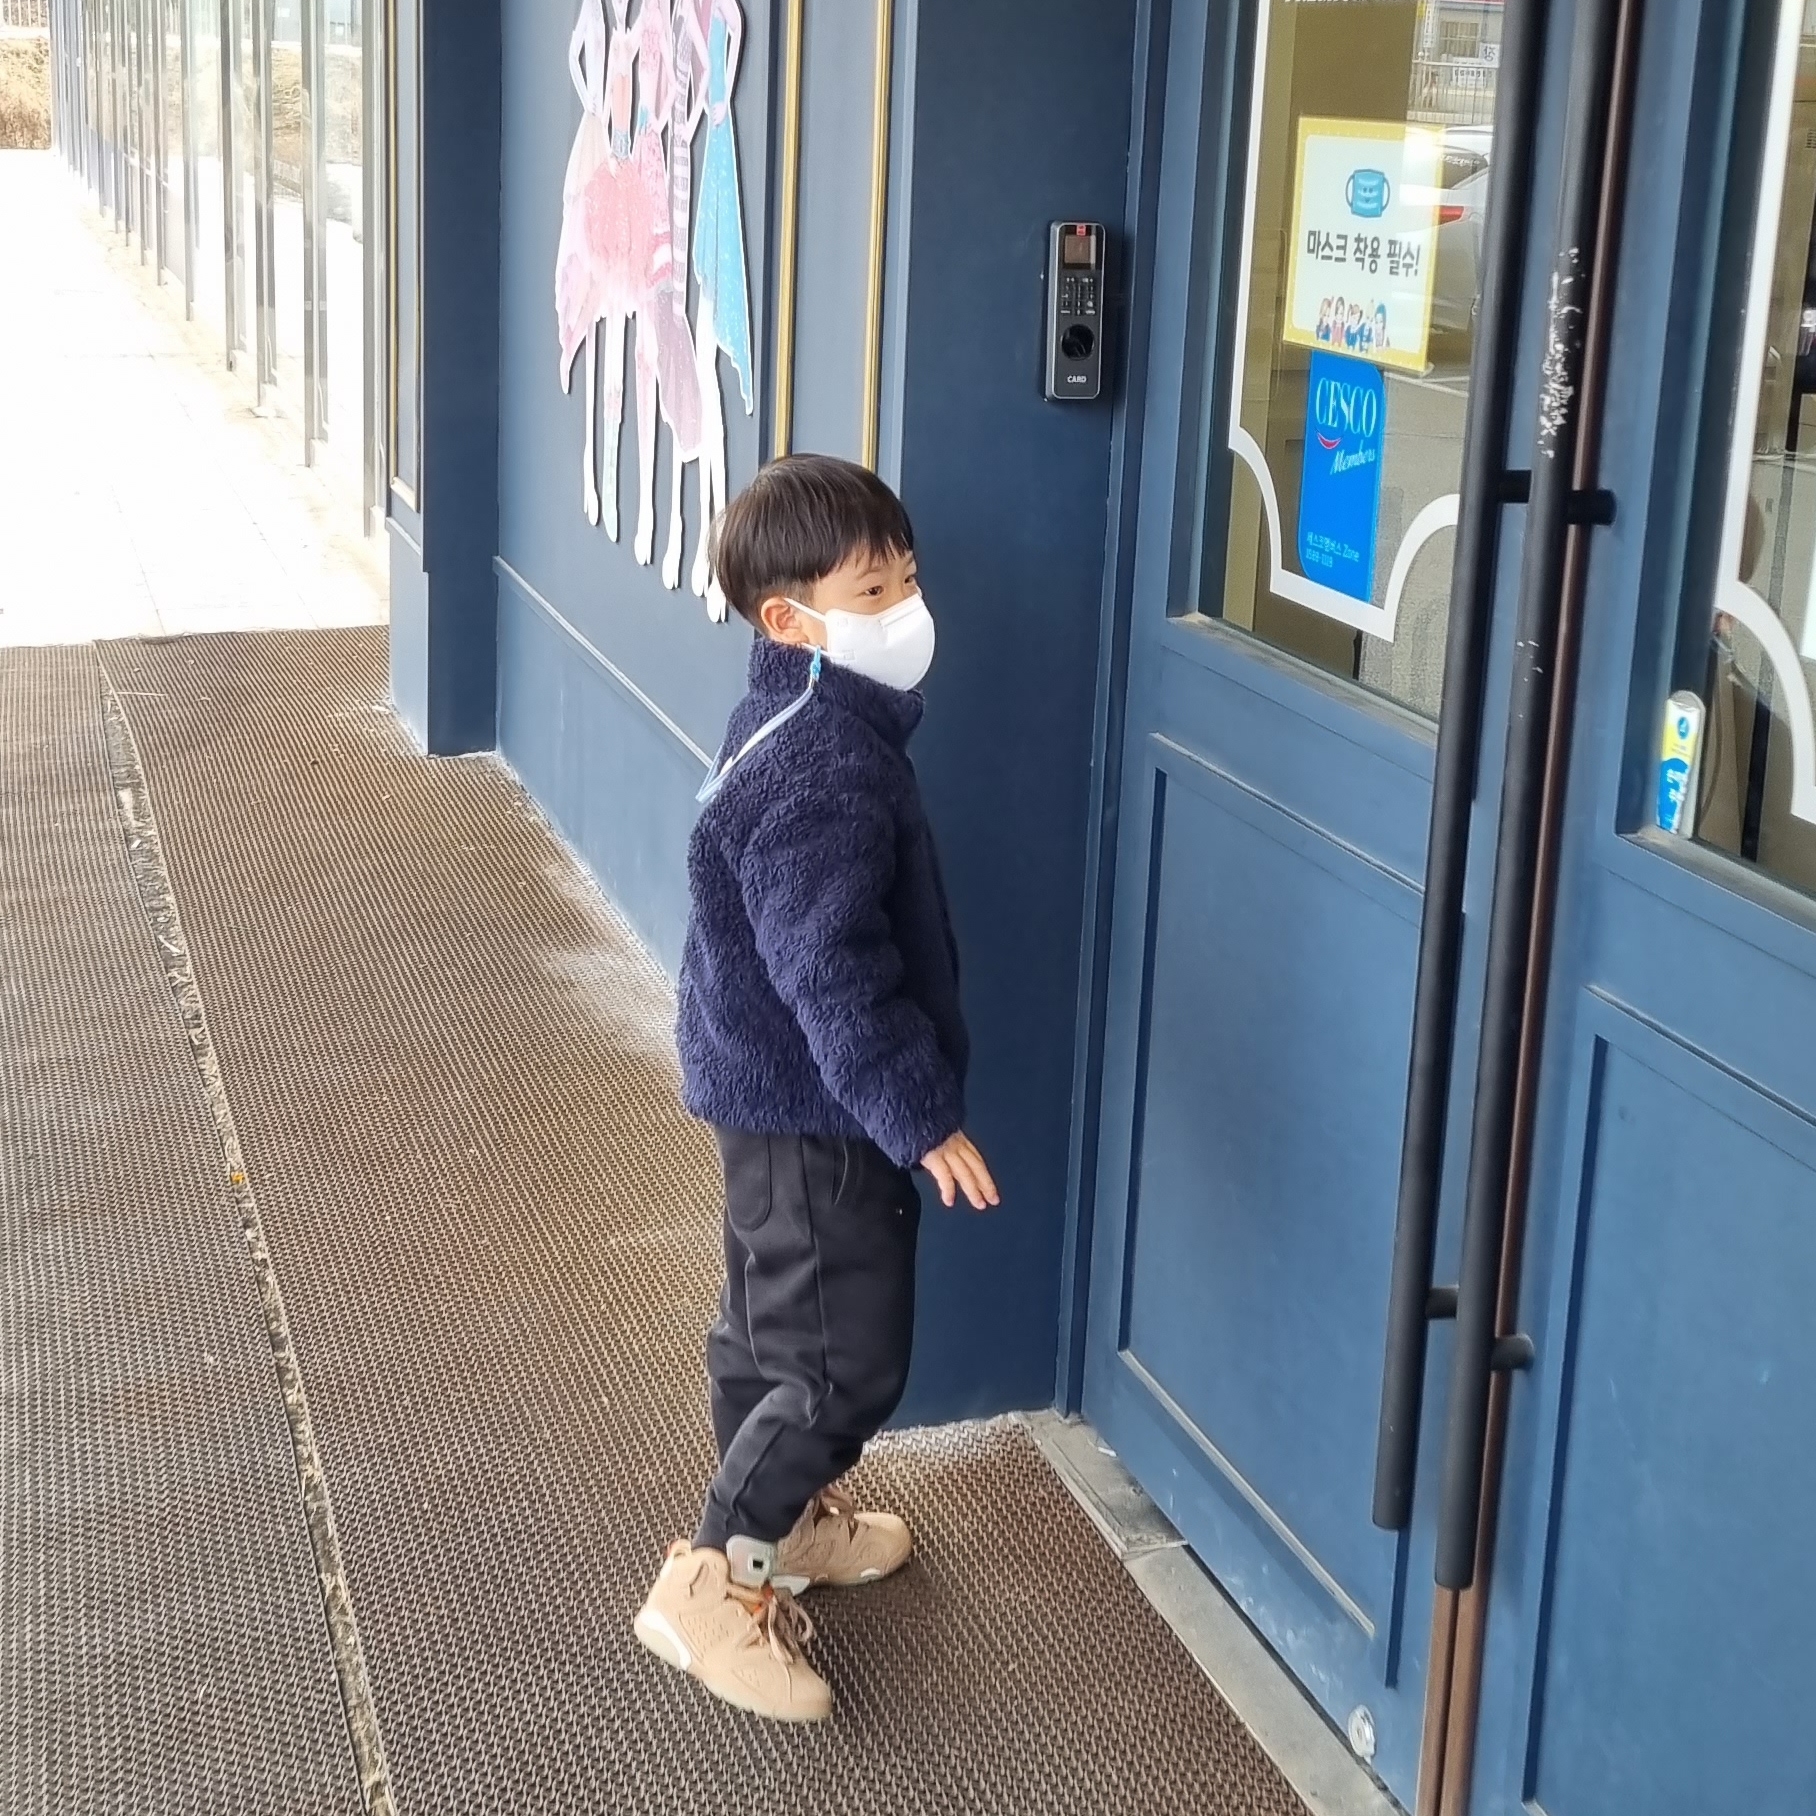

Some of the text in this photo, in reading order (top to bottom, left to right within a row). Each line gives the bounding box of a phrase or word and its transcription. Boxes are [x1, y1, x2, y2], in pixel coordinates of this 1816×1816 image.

[1307, 230, 1421, 278] 마스크 착용 필수!
[1067, 375, 1087, 383] CARD
[1316, 377, 1377, 438] CESCO
